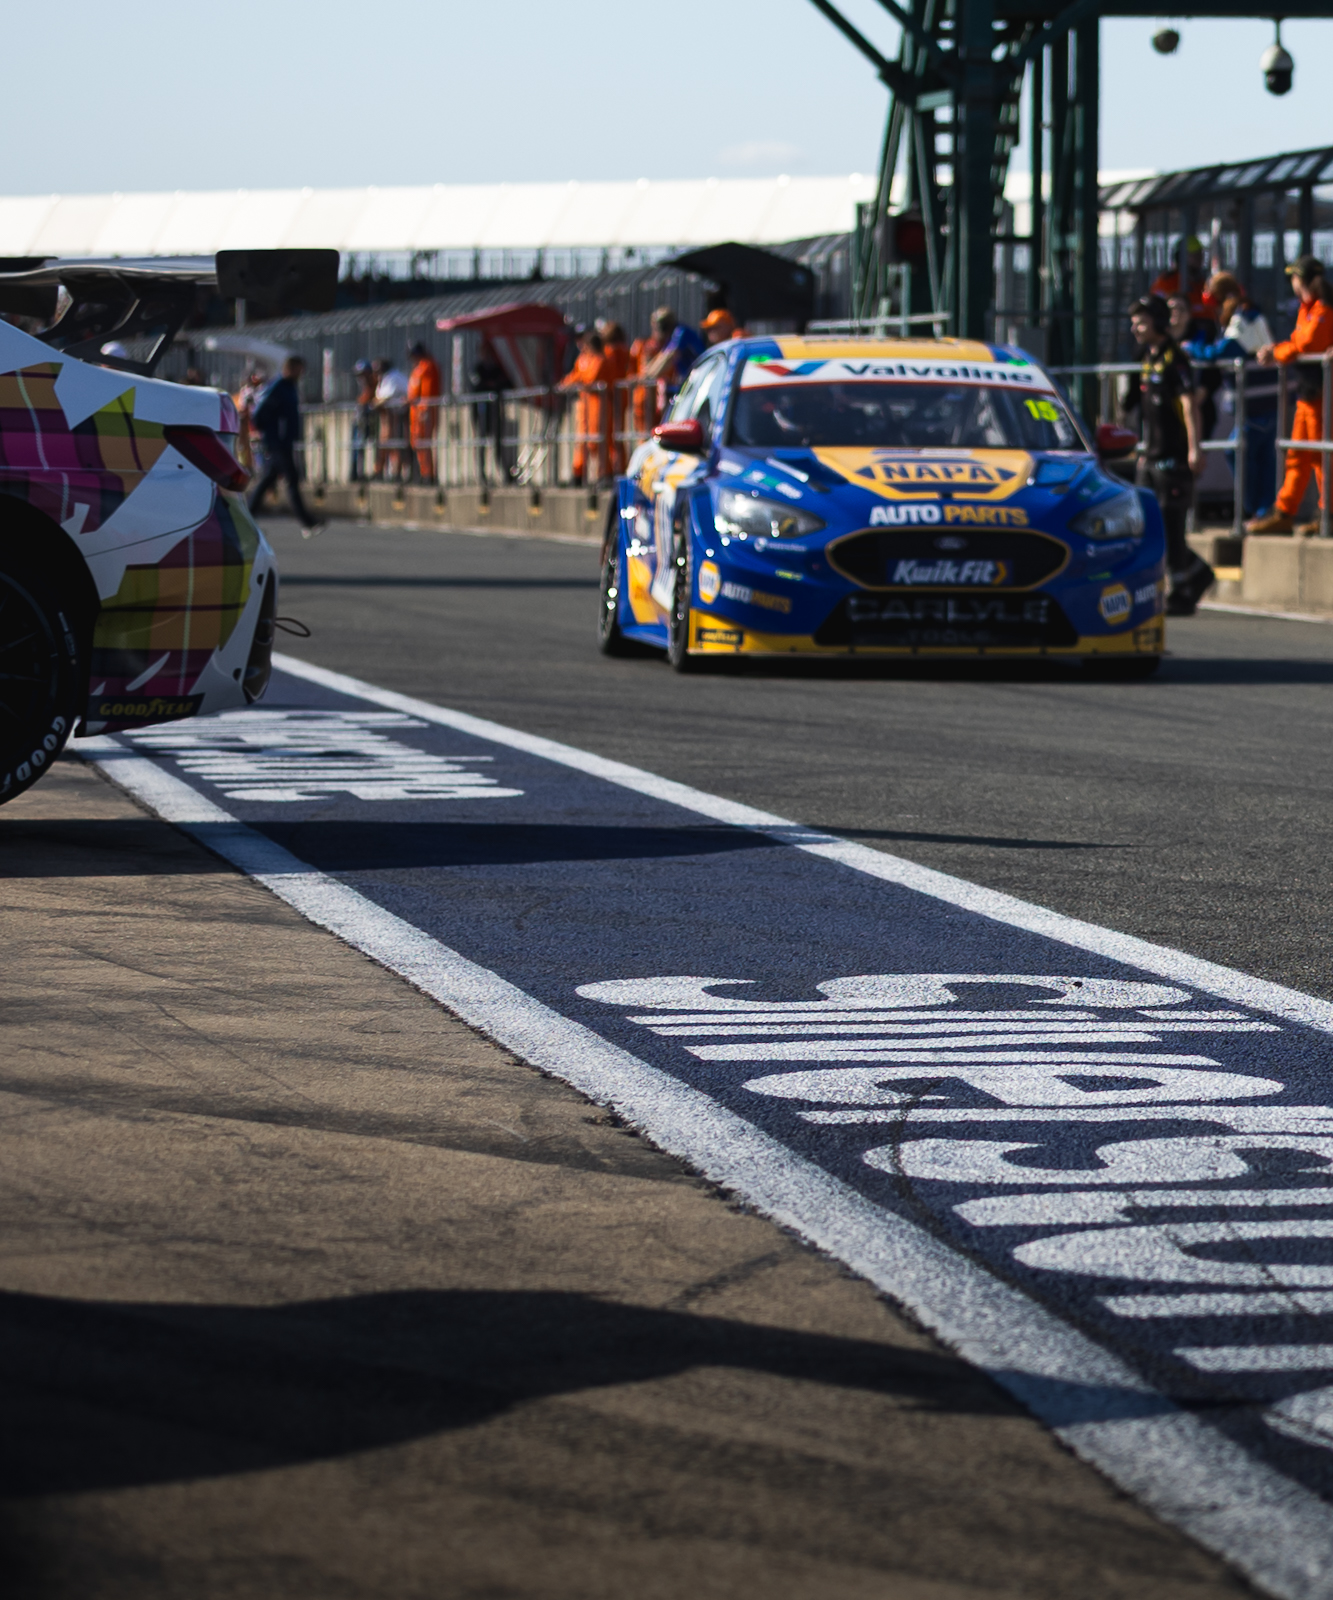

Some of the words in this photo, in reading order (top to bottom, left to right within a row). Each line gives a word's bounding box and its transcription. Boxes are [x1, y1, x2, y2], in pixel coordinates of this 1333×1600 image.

[842, 363, 1033, 382] Valvoline
[880, 464, 992, 481] NAPA
[869, 504, 941, 527] AUTO
[943, 505, 1029, 526] PARTS
[100, 698, 194, 716] GOODYEAR
